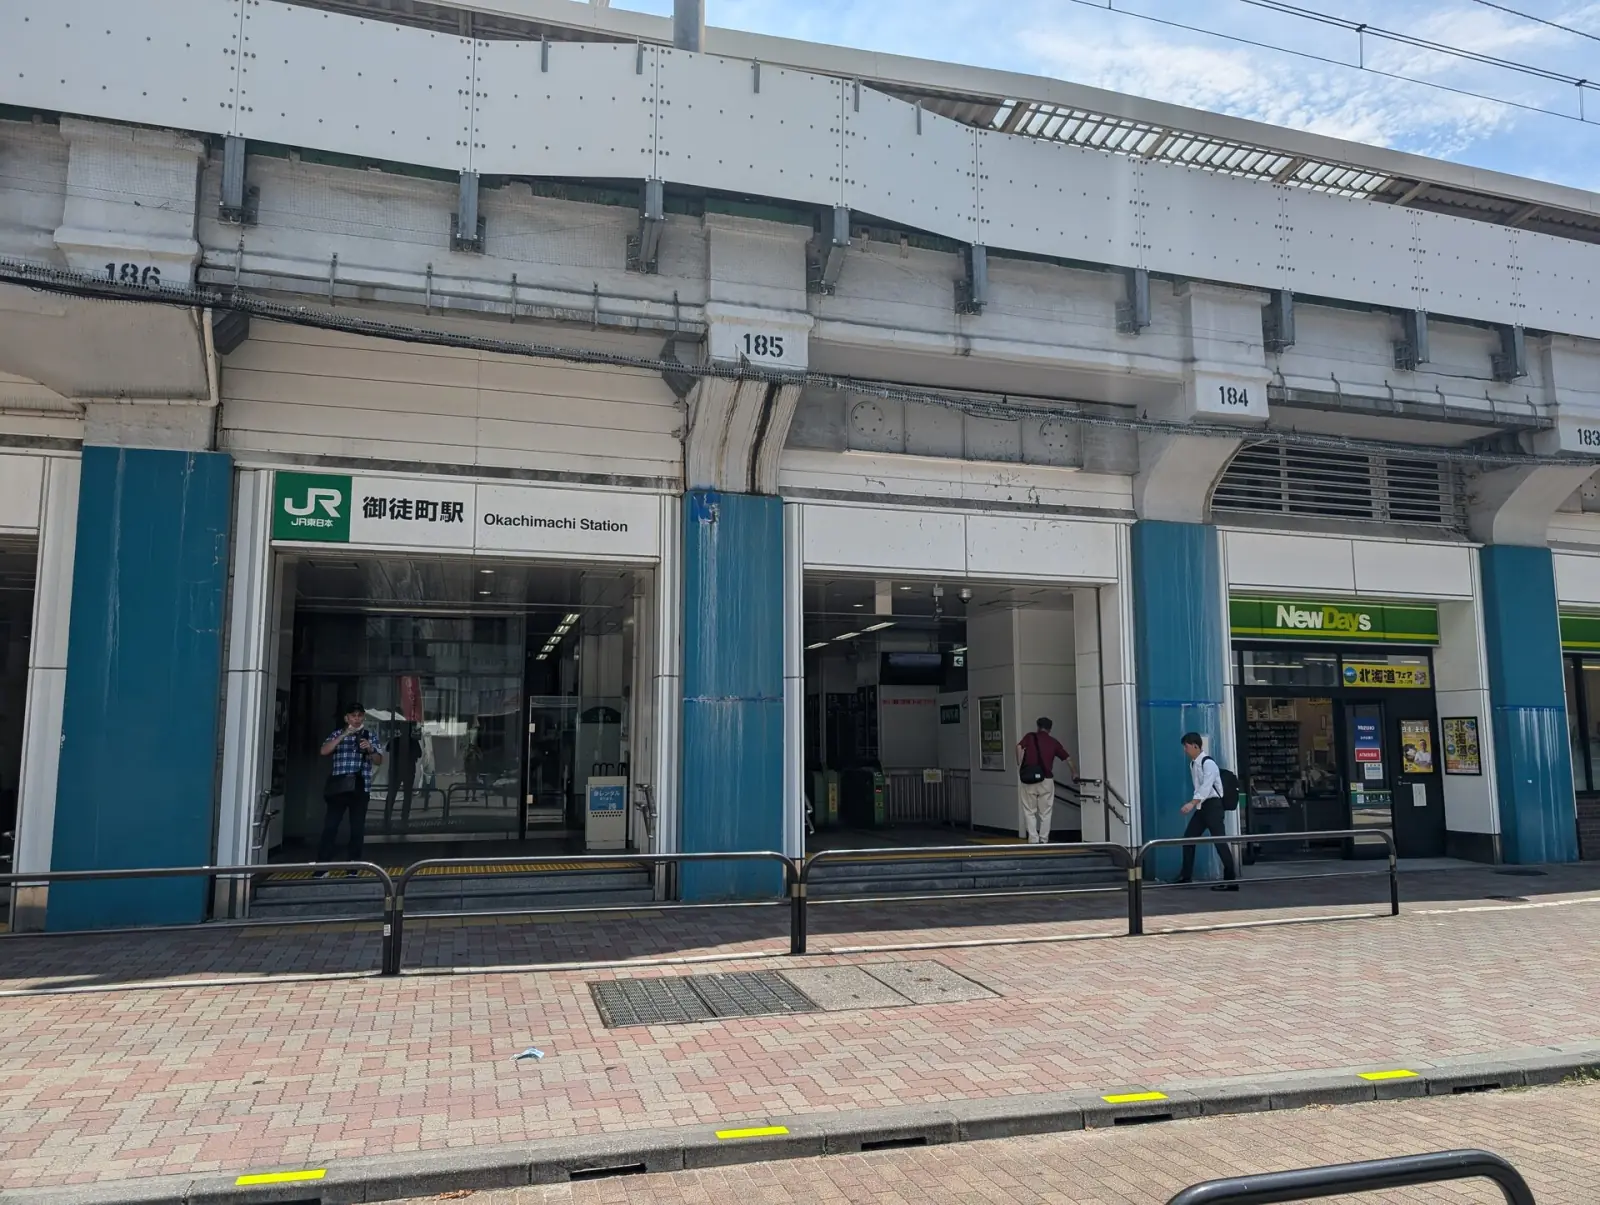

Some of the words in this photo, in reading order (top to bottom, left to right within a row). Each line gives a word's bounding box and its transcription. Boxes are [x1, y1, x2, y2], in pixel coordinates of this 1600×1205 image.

[105, 262, 161, 286] 186
[743, 333, 784, 358] 185
[1218, 385, 1249, 407] 184
[1577, 428, 1600, 446] 183
[284, 487, 342, 518] JR
[362, 496, 464, 523] 御徒町駅
[291, 517, 334, 527] JR東日本
[483, 513, 576, 530] Okachimachi
[580, 518, 628, 532] Station
[1276, 605, 1371, 632] NewDays
